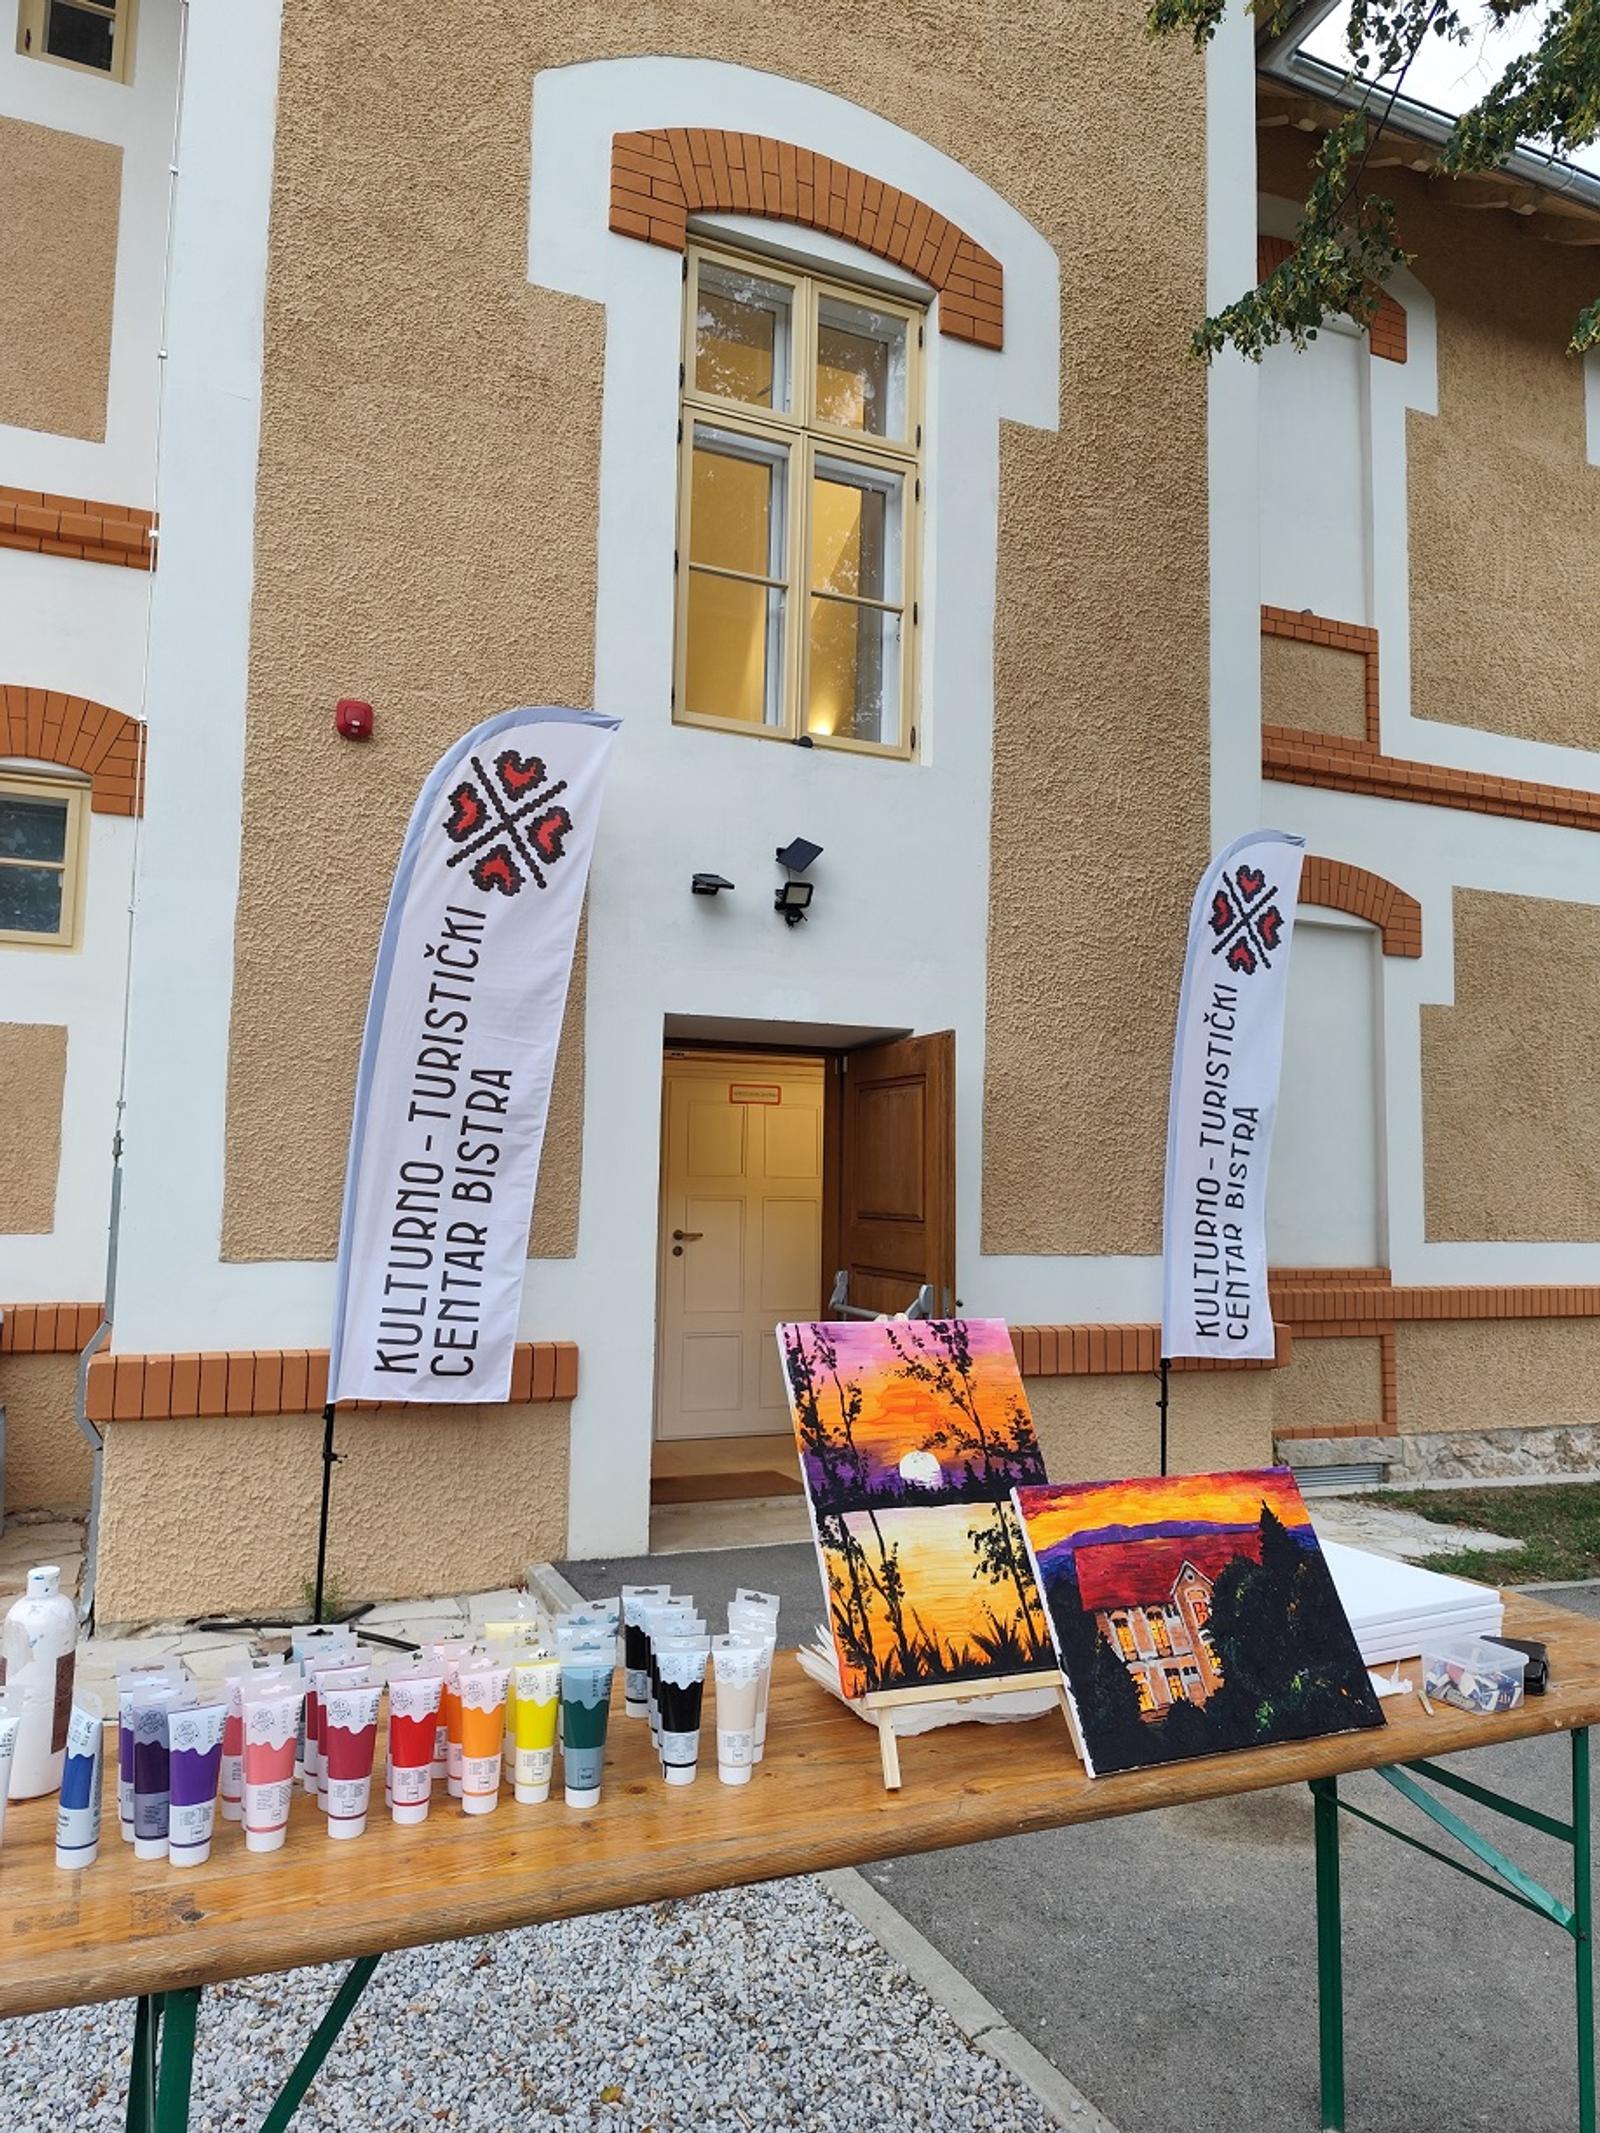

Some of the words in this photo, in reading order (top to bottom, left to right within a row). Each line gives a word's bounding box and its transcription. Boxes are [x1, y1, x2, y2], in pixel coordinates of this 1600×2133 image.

[407, 904, 488, 1122] TURISTIČKI
[1198, 983, 1239, 1148] TURISTIČKI
[451, 1069, 513, 1204] BISTRA
[1224, 1107, 1260, 1211] BISTRA
[373, 1161, 444, 1376] KULTURNO
[429, 1221, 488, 1378] CENTAR
[1193, 1177, 1222, 1338] KULTURNO
[1222, 1223, 1251, 1342] CENTAR
